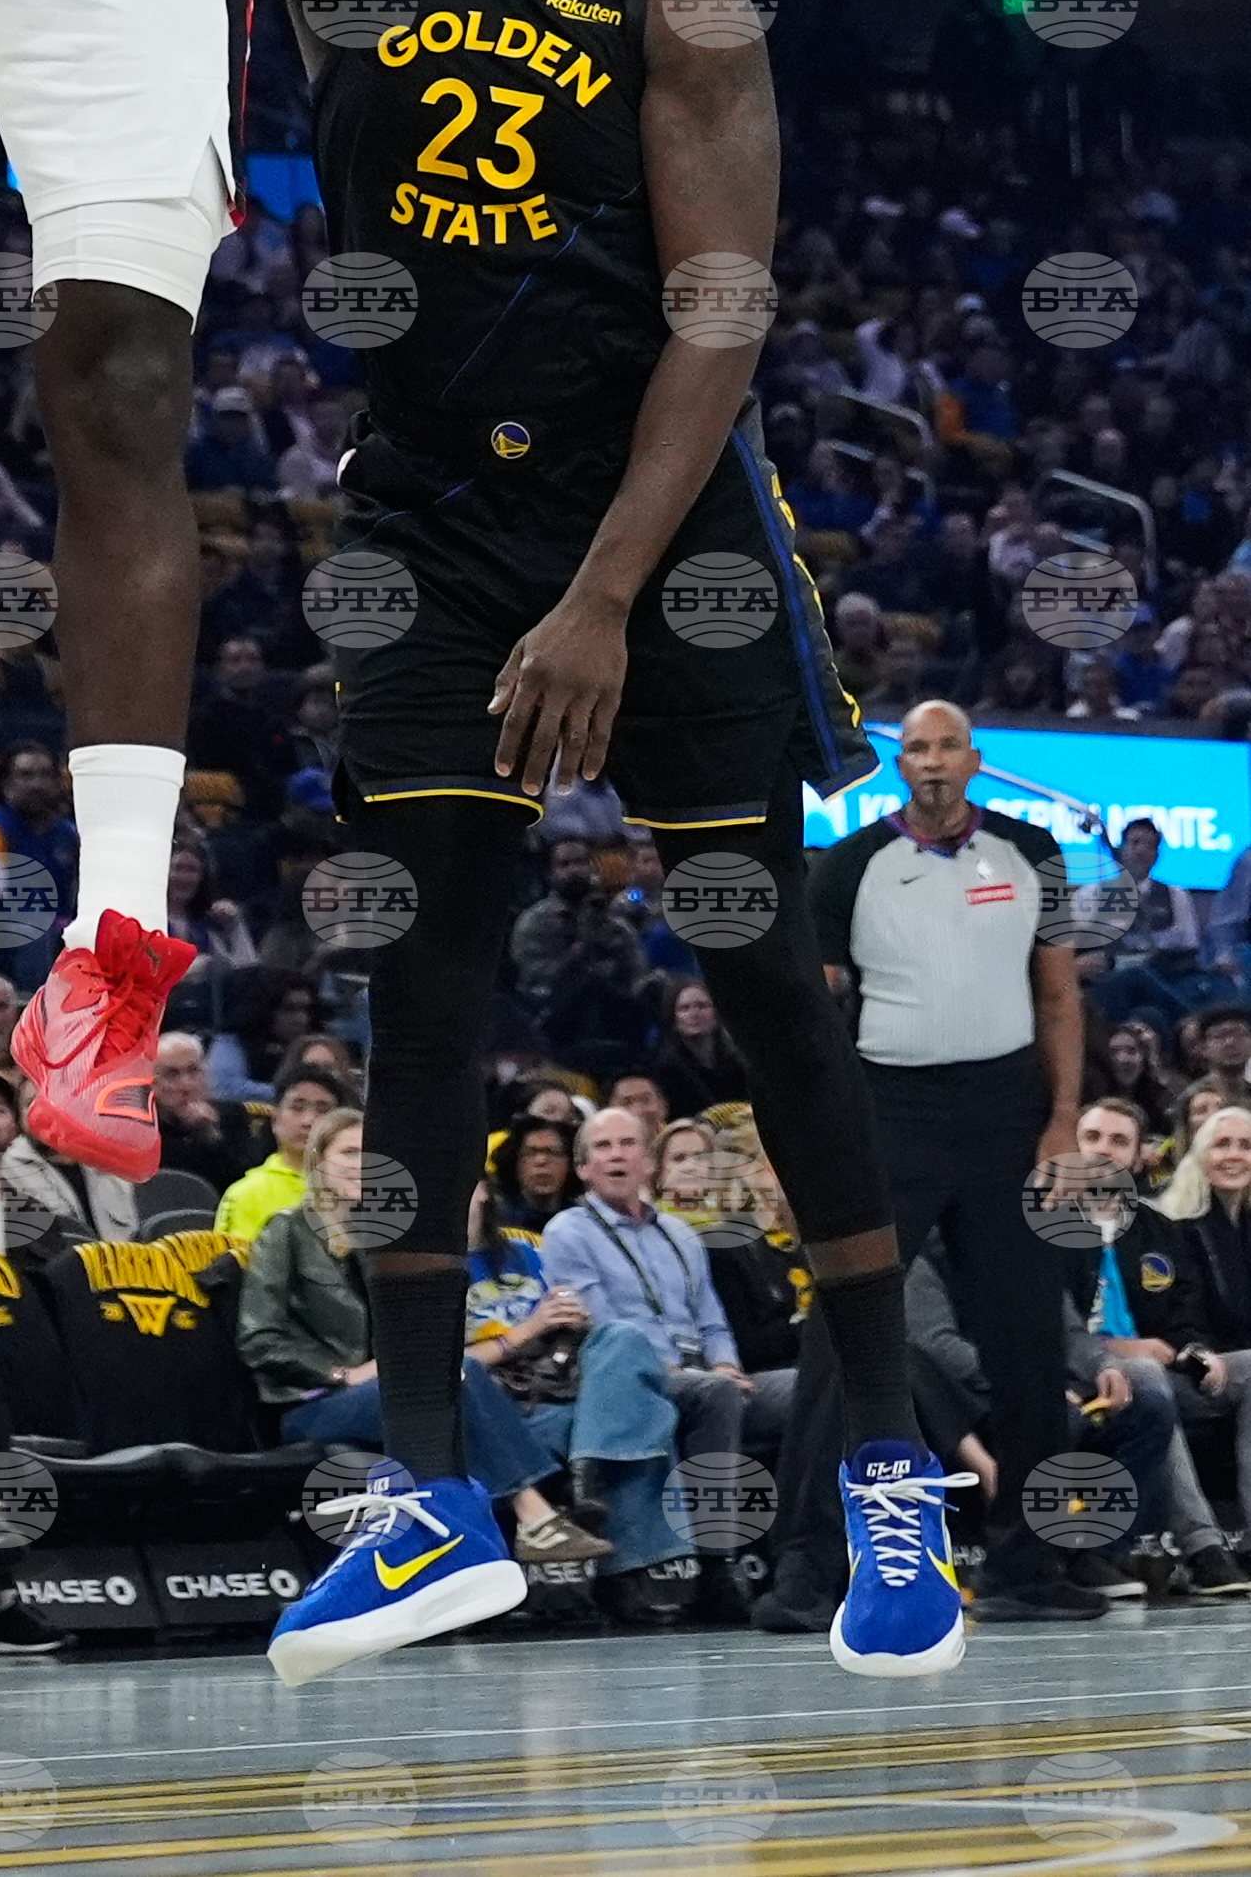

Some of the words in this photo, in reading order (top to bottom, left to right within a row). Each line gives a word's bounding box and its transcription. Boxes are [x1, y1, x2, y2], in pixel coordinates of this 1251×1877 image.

[377, 10, 612, 108] GOLDEN
[417, 77, 545, 189] 23
[390, 182, 557, 246] STATE
[16, 1579, 108, 1605] HASE
[165, 1573, 271, 1599] CHASE
